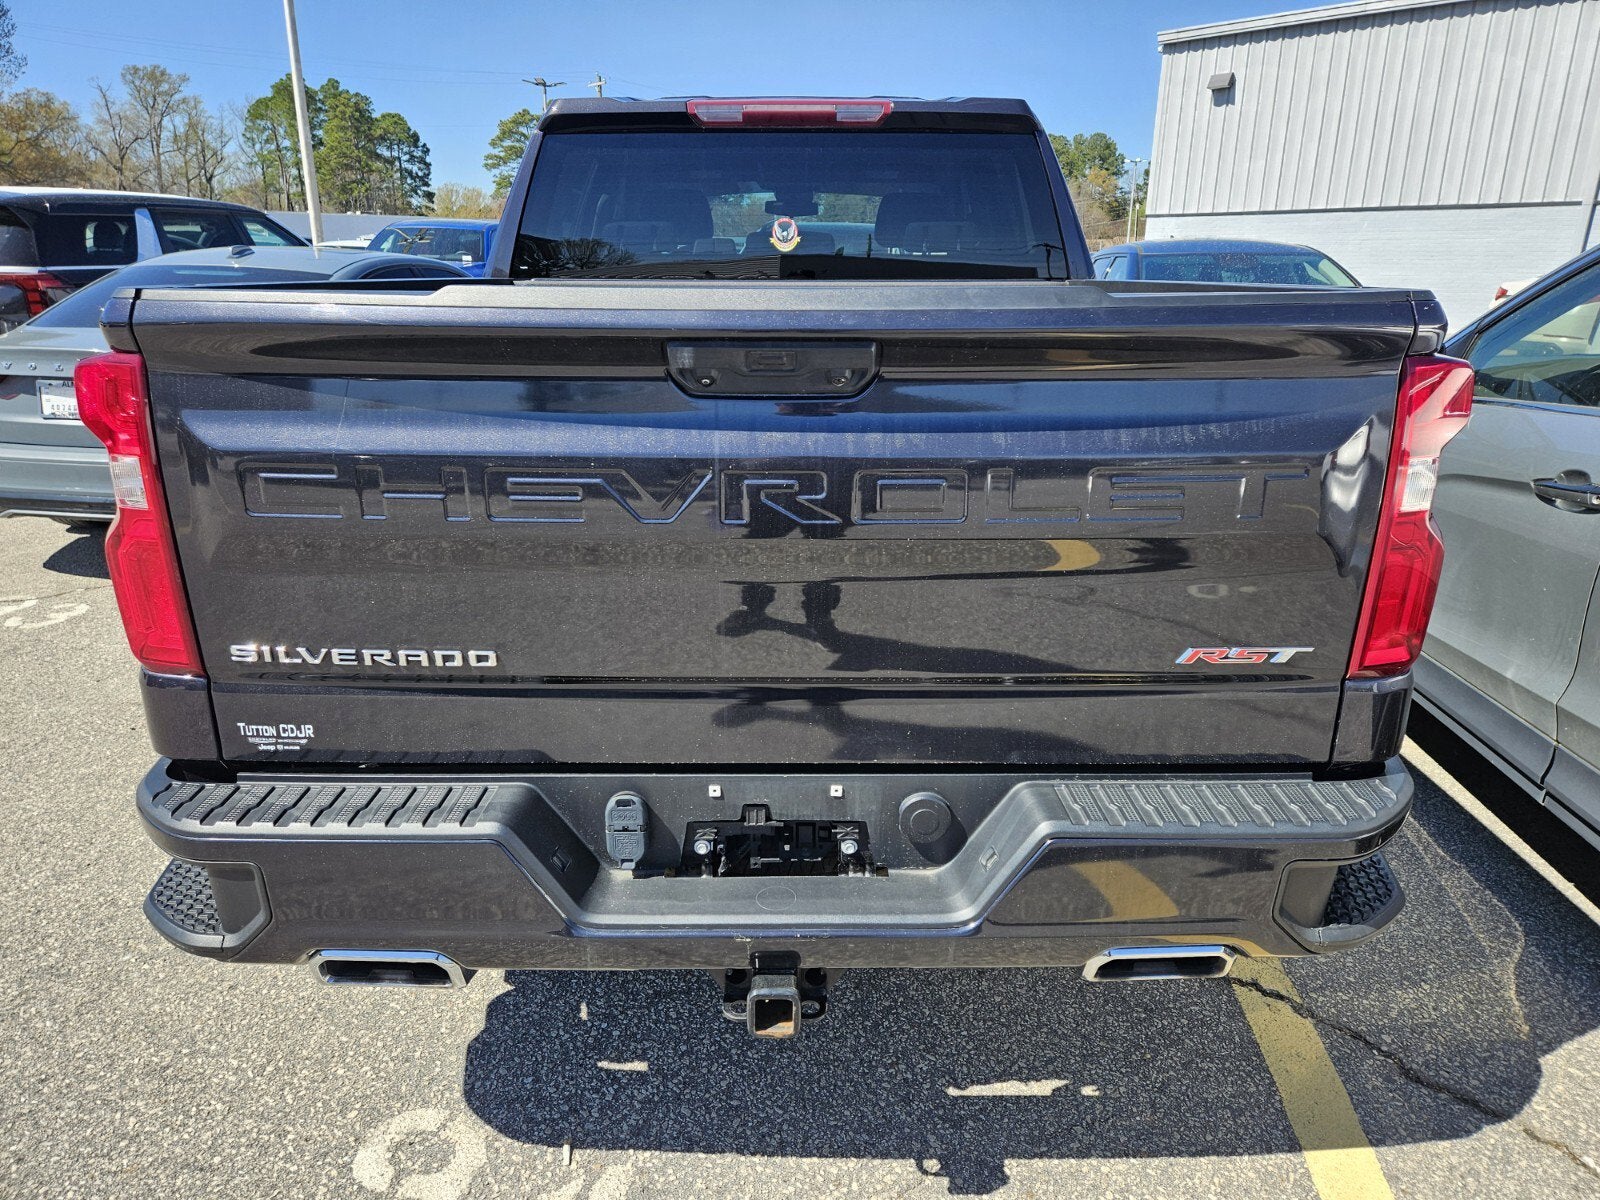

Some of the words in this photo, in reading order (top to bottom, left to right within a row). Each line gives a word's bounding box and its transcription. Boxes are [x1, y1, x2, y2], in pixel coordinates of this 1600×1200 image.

[236, 462, 1311, 526] CHEVROLET
[229, 643, 498, 667] SILVERADO
[1175, 647, 1315, 664] RST
[237, 722, 277, 737] TUTTON
[279, 724, 315, 738] CDJR
